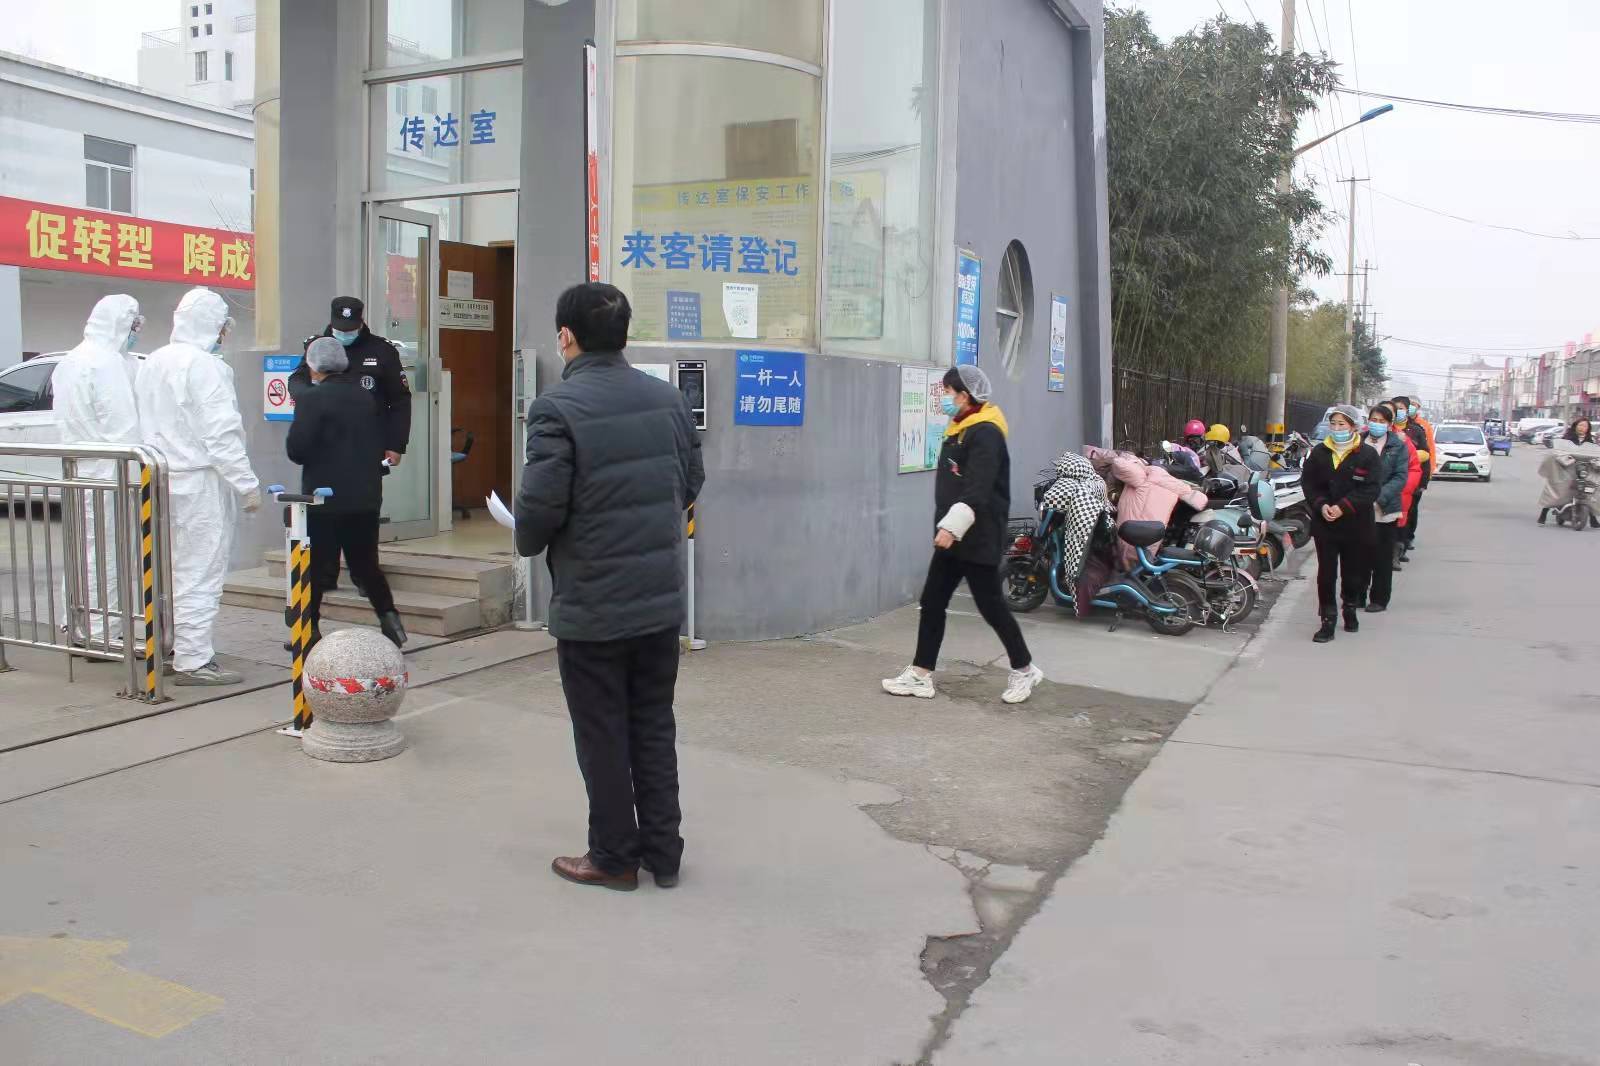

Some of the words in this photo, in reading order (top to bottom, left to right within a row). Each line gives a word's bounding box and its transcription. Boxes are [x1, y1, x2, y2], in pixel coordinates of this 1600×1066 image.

[400, 108, 496, 151] 传达室
[26, 210, 153, 270] 促转型
[183, 232, 252, 281] 降成
[620, 230, 799, 276] 来客请登记
[741, 368, 802, 387] 一杆一人
[740, 395, 801, 413] 请勿尾随
